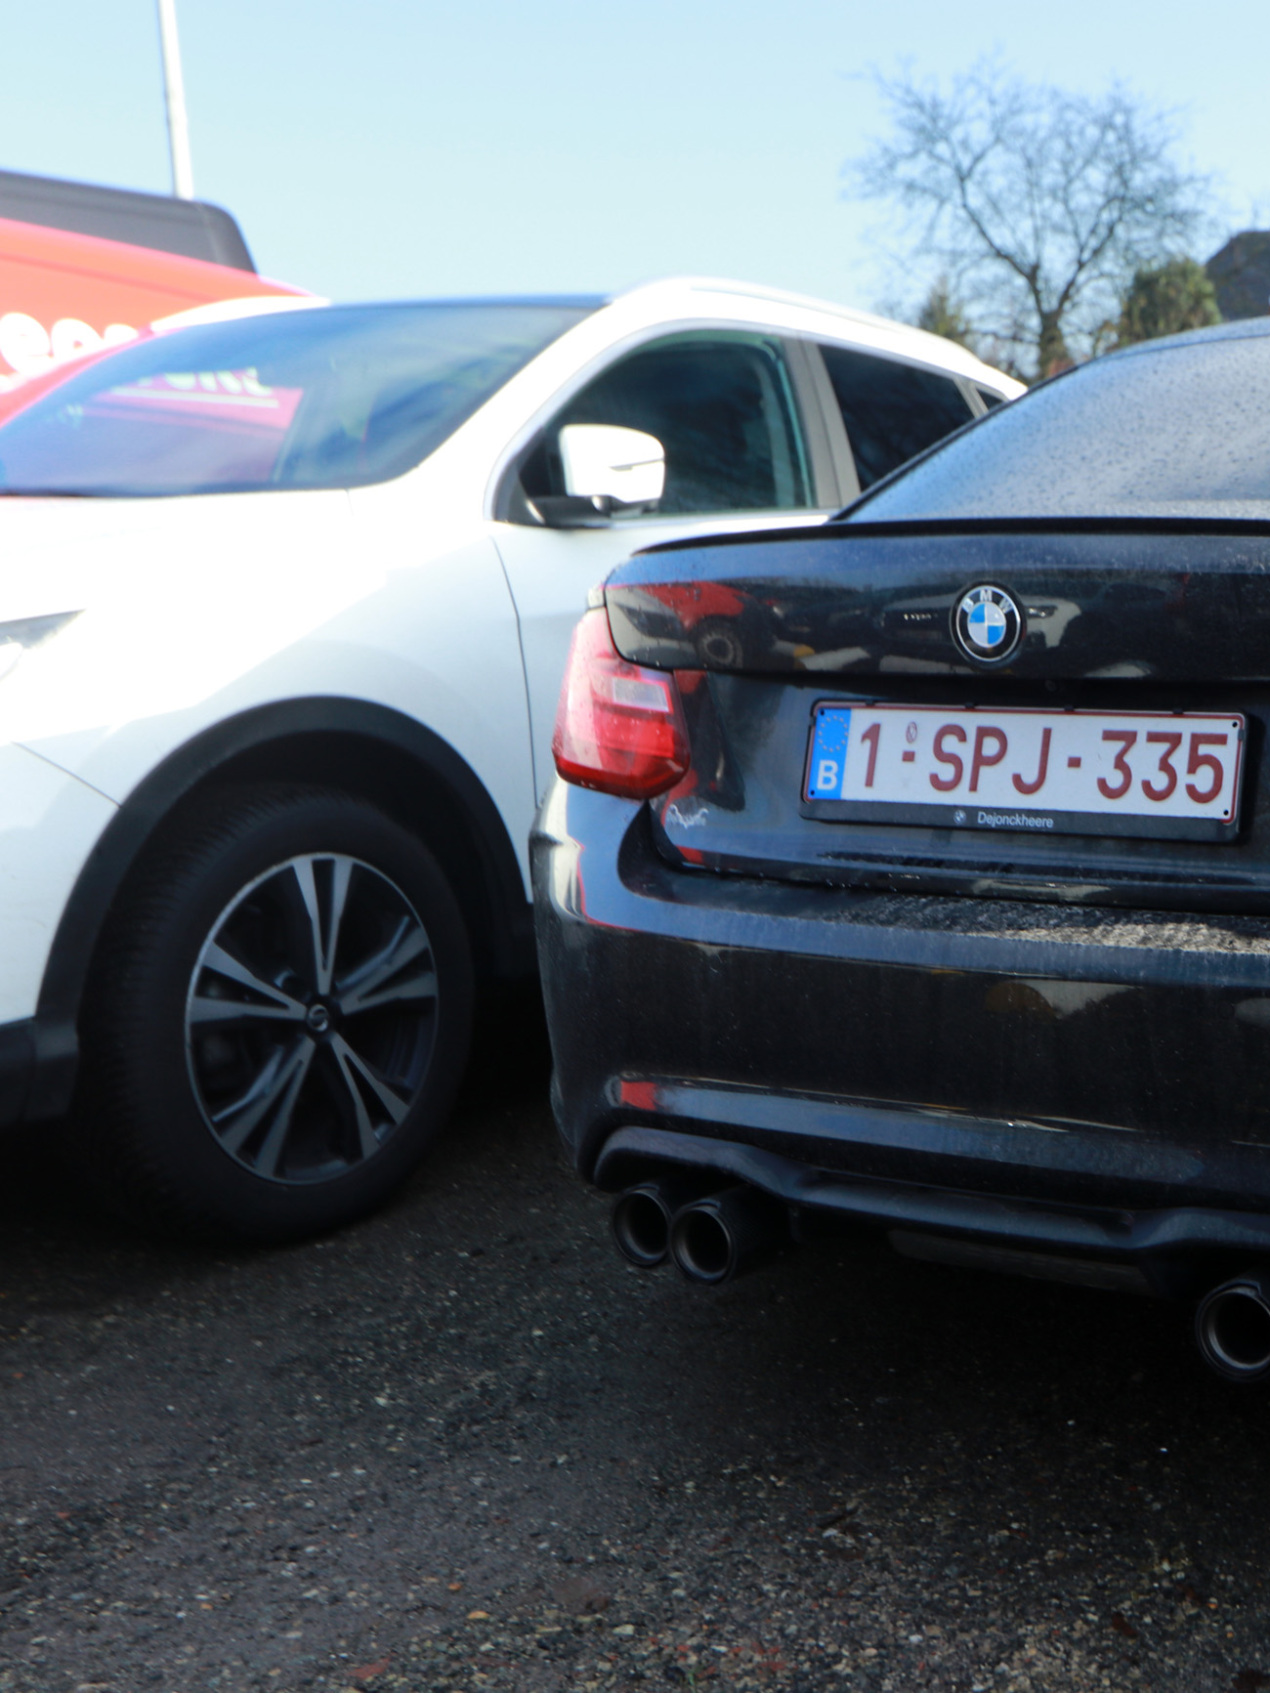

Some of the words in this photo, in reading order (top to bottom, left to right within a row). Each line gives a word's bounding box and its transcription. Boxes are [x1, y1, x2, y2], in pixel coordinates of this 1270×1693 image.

[962, 588, 1013, 614] BMW
[817, 760, 839, 790] B
[860, 722, 1229, 804] 1-SPJ-335
[977, 811, 1054, 829] Dejonckheere
